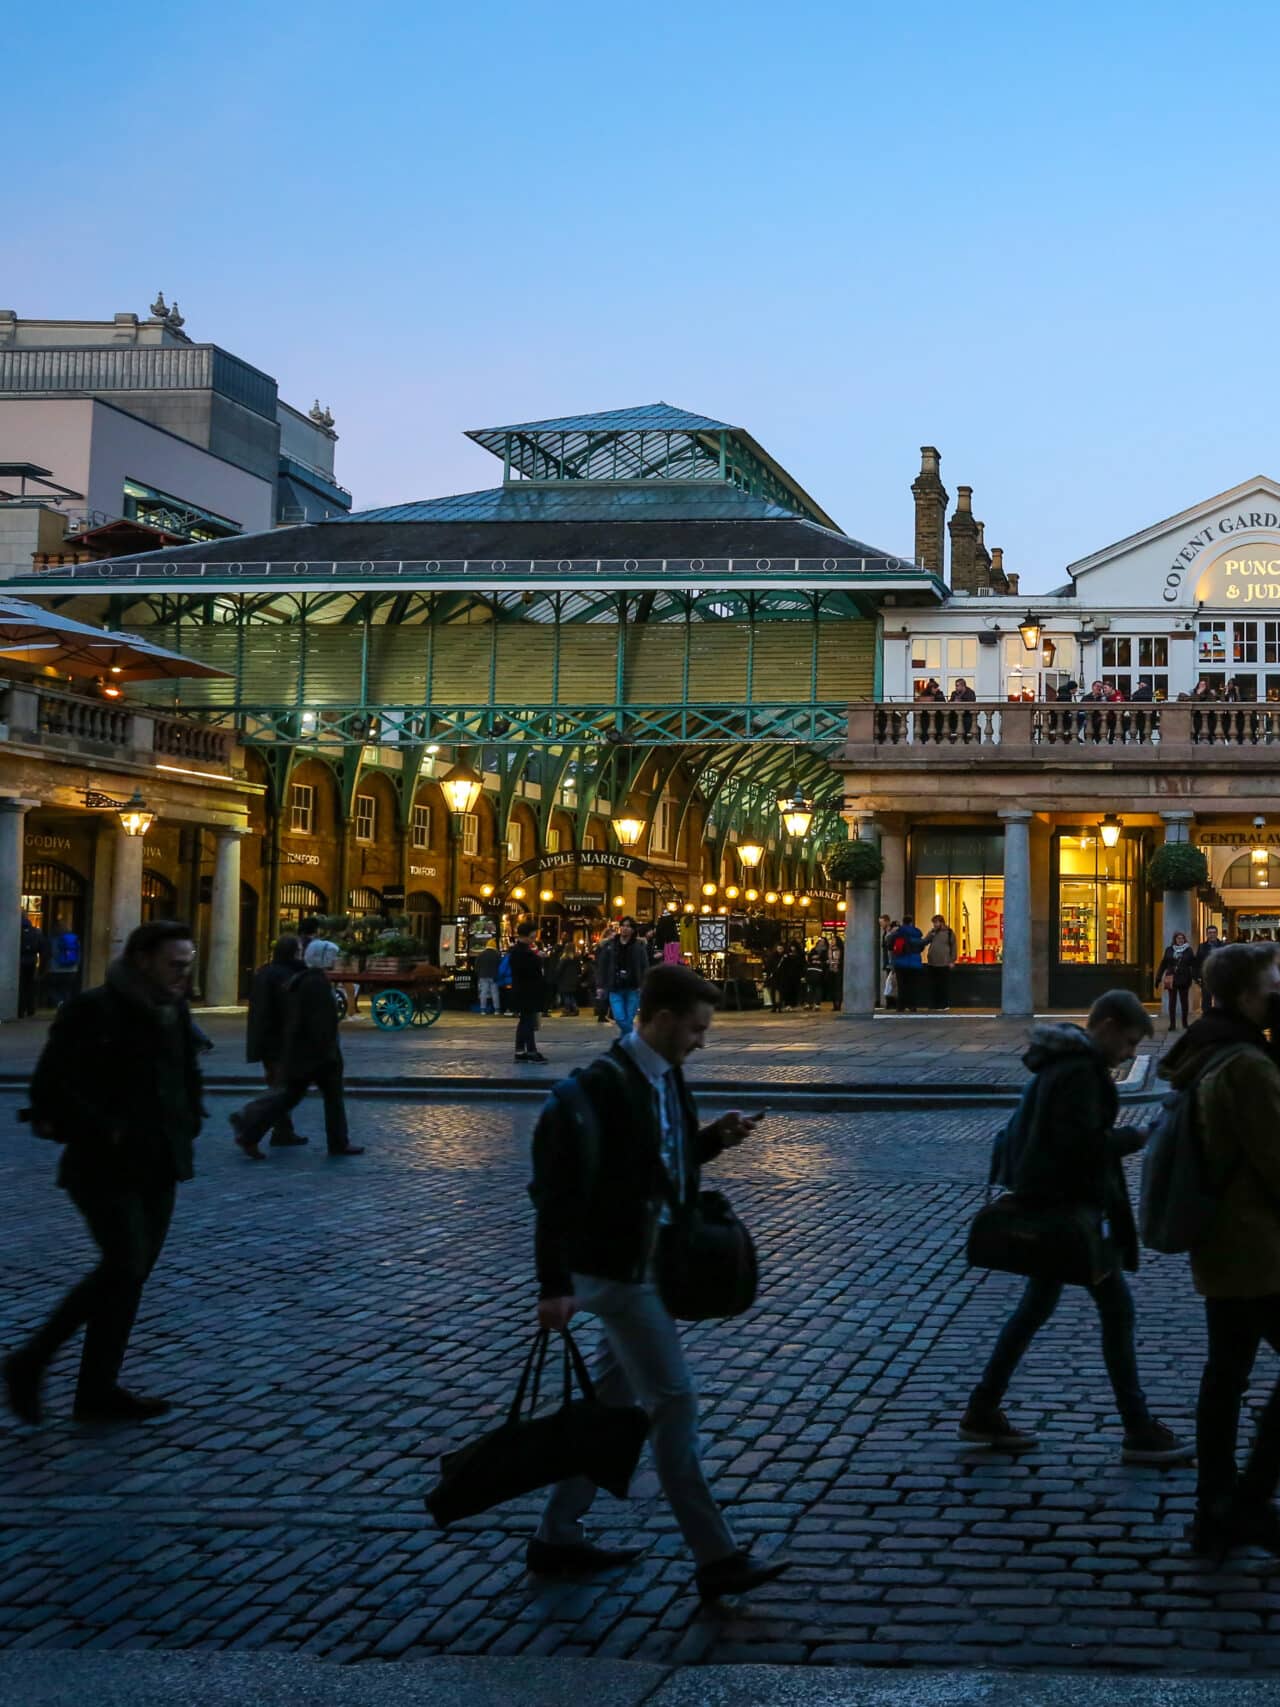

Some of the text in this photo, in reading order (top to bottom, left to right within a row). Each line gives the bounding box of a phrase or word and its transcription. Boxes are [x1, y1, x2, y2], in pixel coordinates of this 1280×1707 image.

[1163, 526, 1214, 602] COVENT
[1225, 583, 1240, 600] &
[24, 833, 72, 849] GODIVA
[1200, 832, 1264, 844] CENTRAL
[301, 854, 320, 865] FORD
[538, 852, 634, 870] APPLE MARKET
[805, 889, 843, 902] MARKET
[984, 897, 998, 947] SALE
